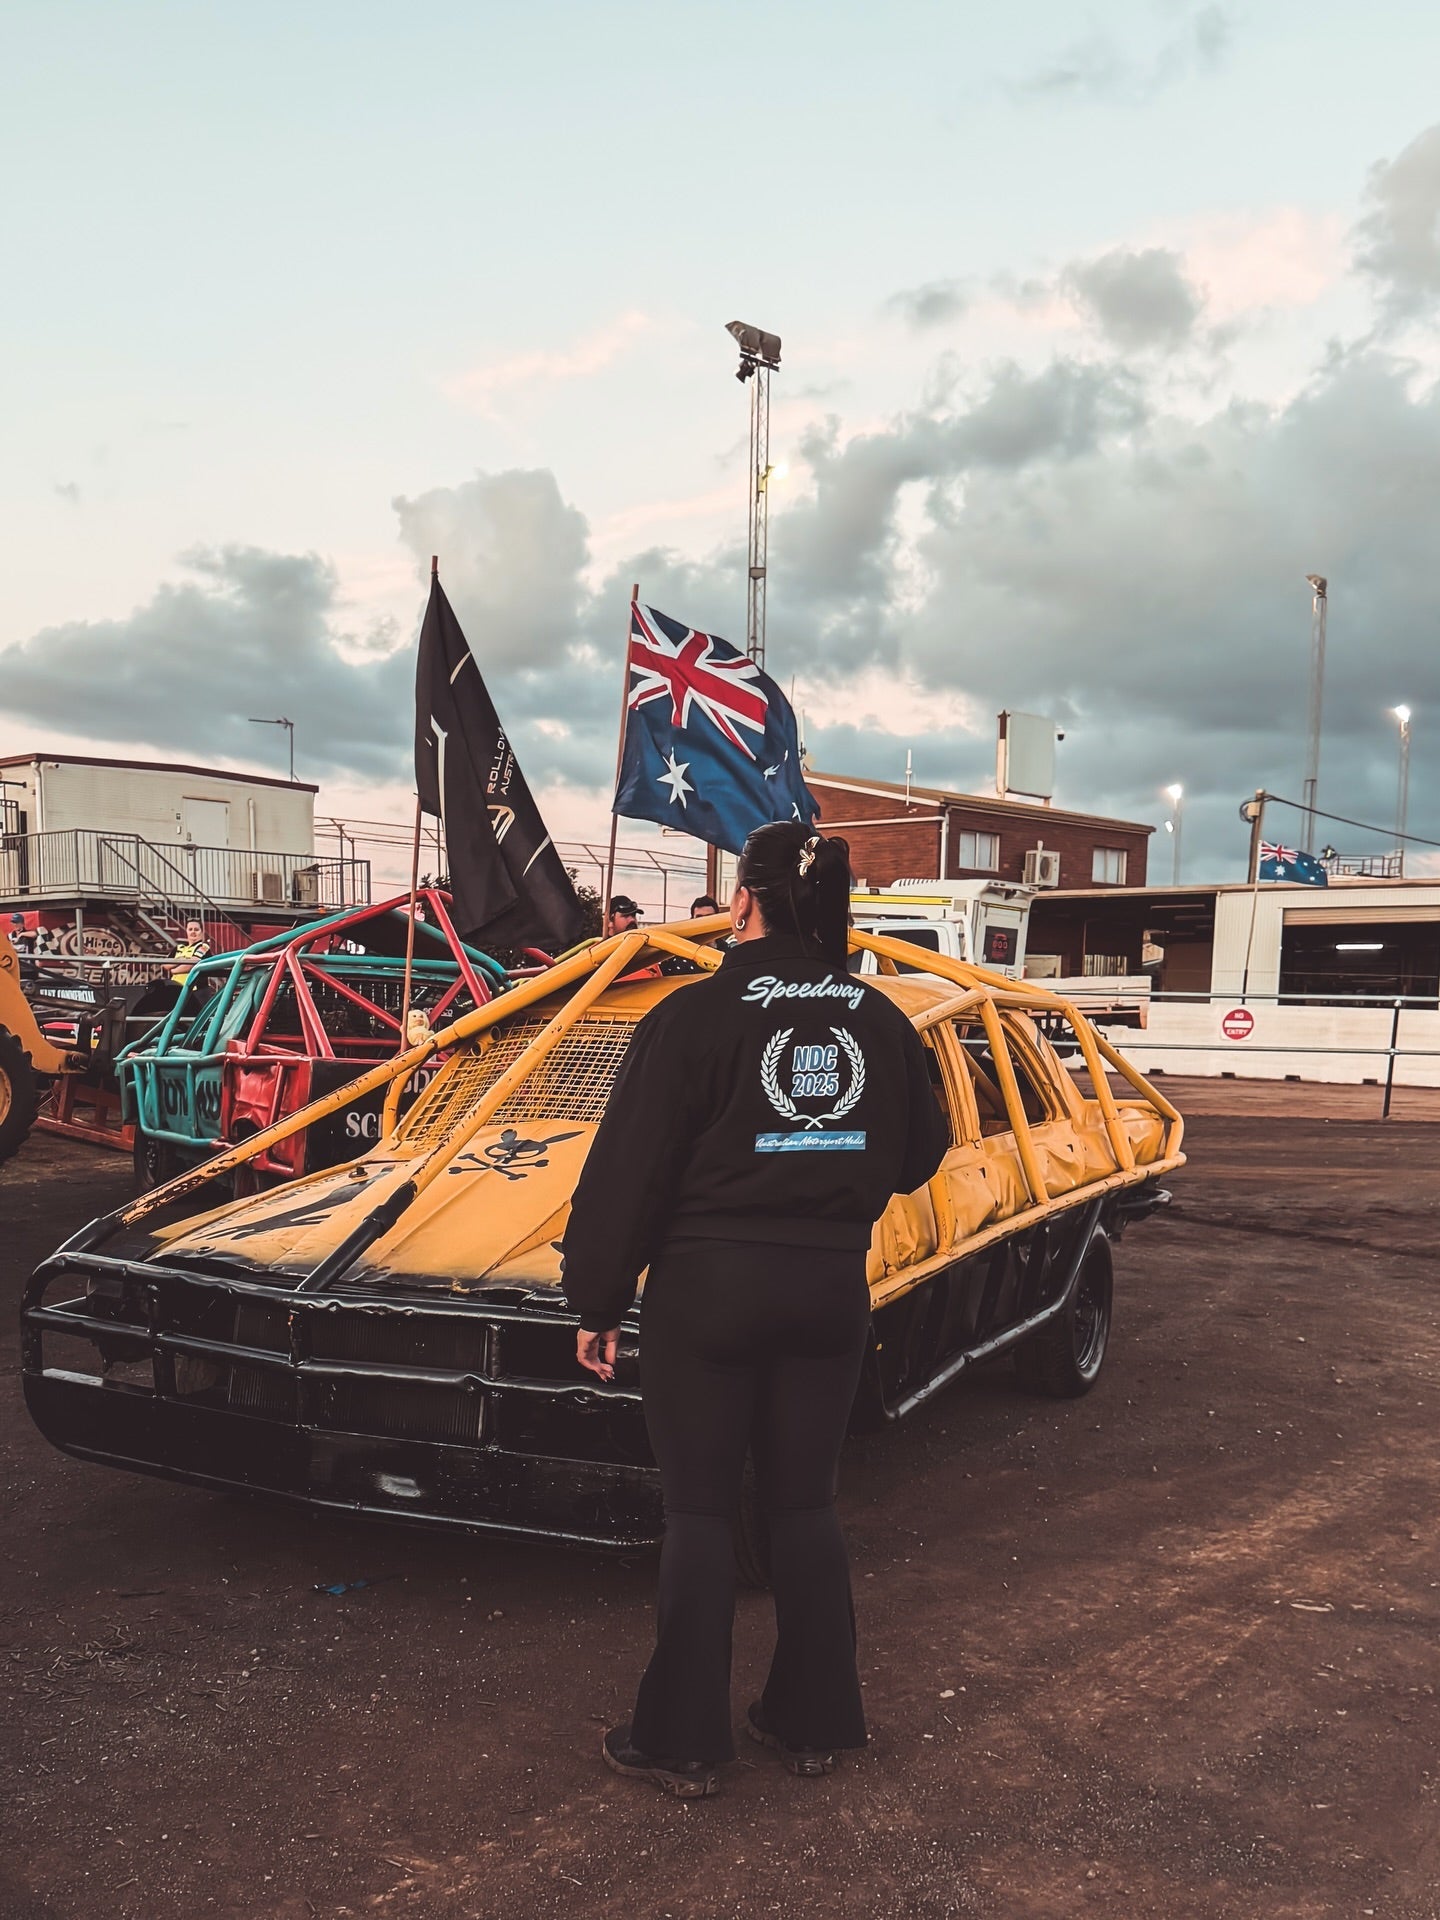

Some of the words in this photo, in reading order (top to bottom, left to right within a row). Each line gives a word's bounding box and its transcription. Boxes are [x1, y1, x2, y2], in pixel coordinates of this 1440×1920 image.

[741, 974, 865, 1010] Speedway
[1226, 1028, 1249, 1036] ENTRY
[792, 1045, 839, 1073] NDC
[791, 1073, 839, 1097] 2025
[755, 1137, 798, 1148] Australian
[798, 1136, 843, 1148] Motorsport
[841, 1135, 865, 1146] Media
